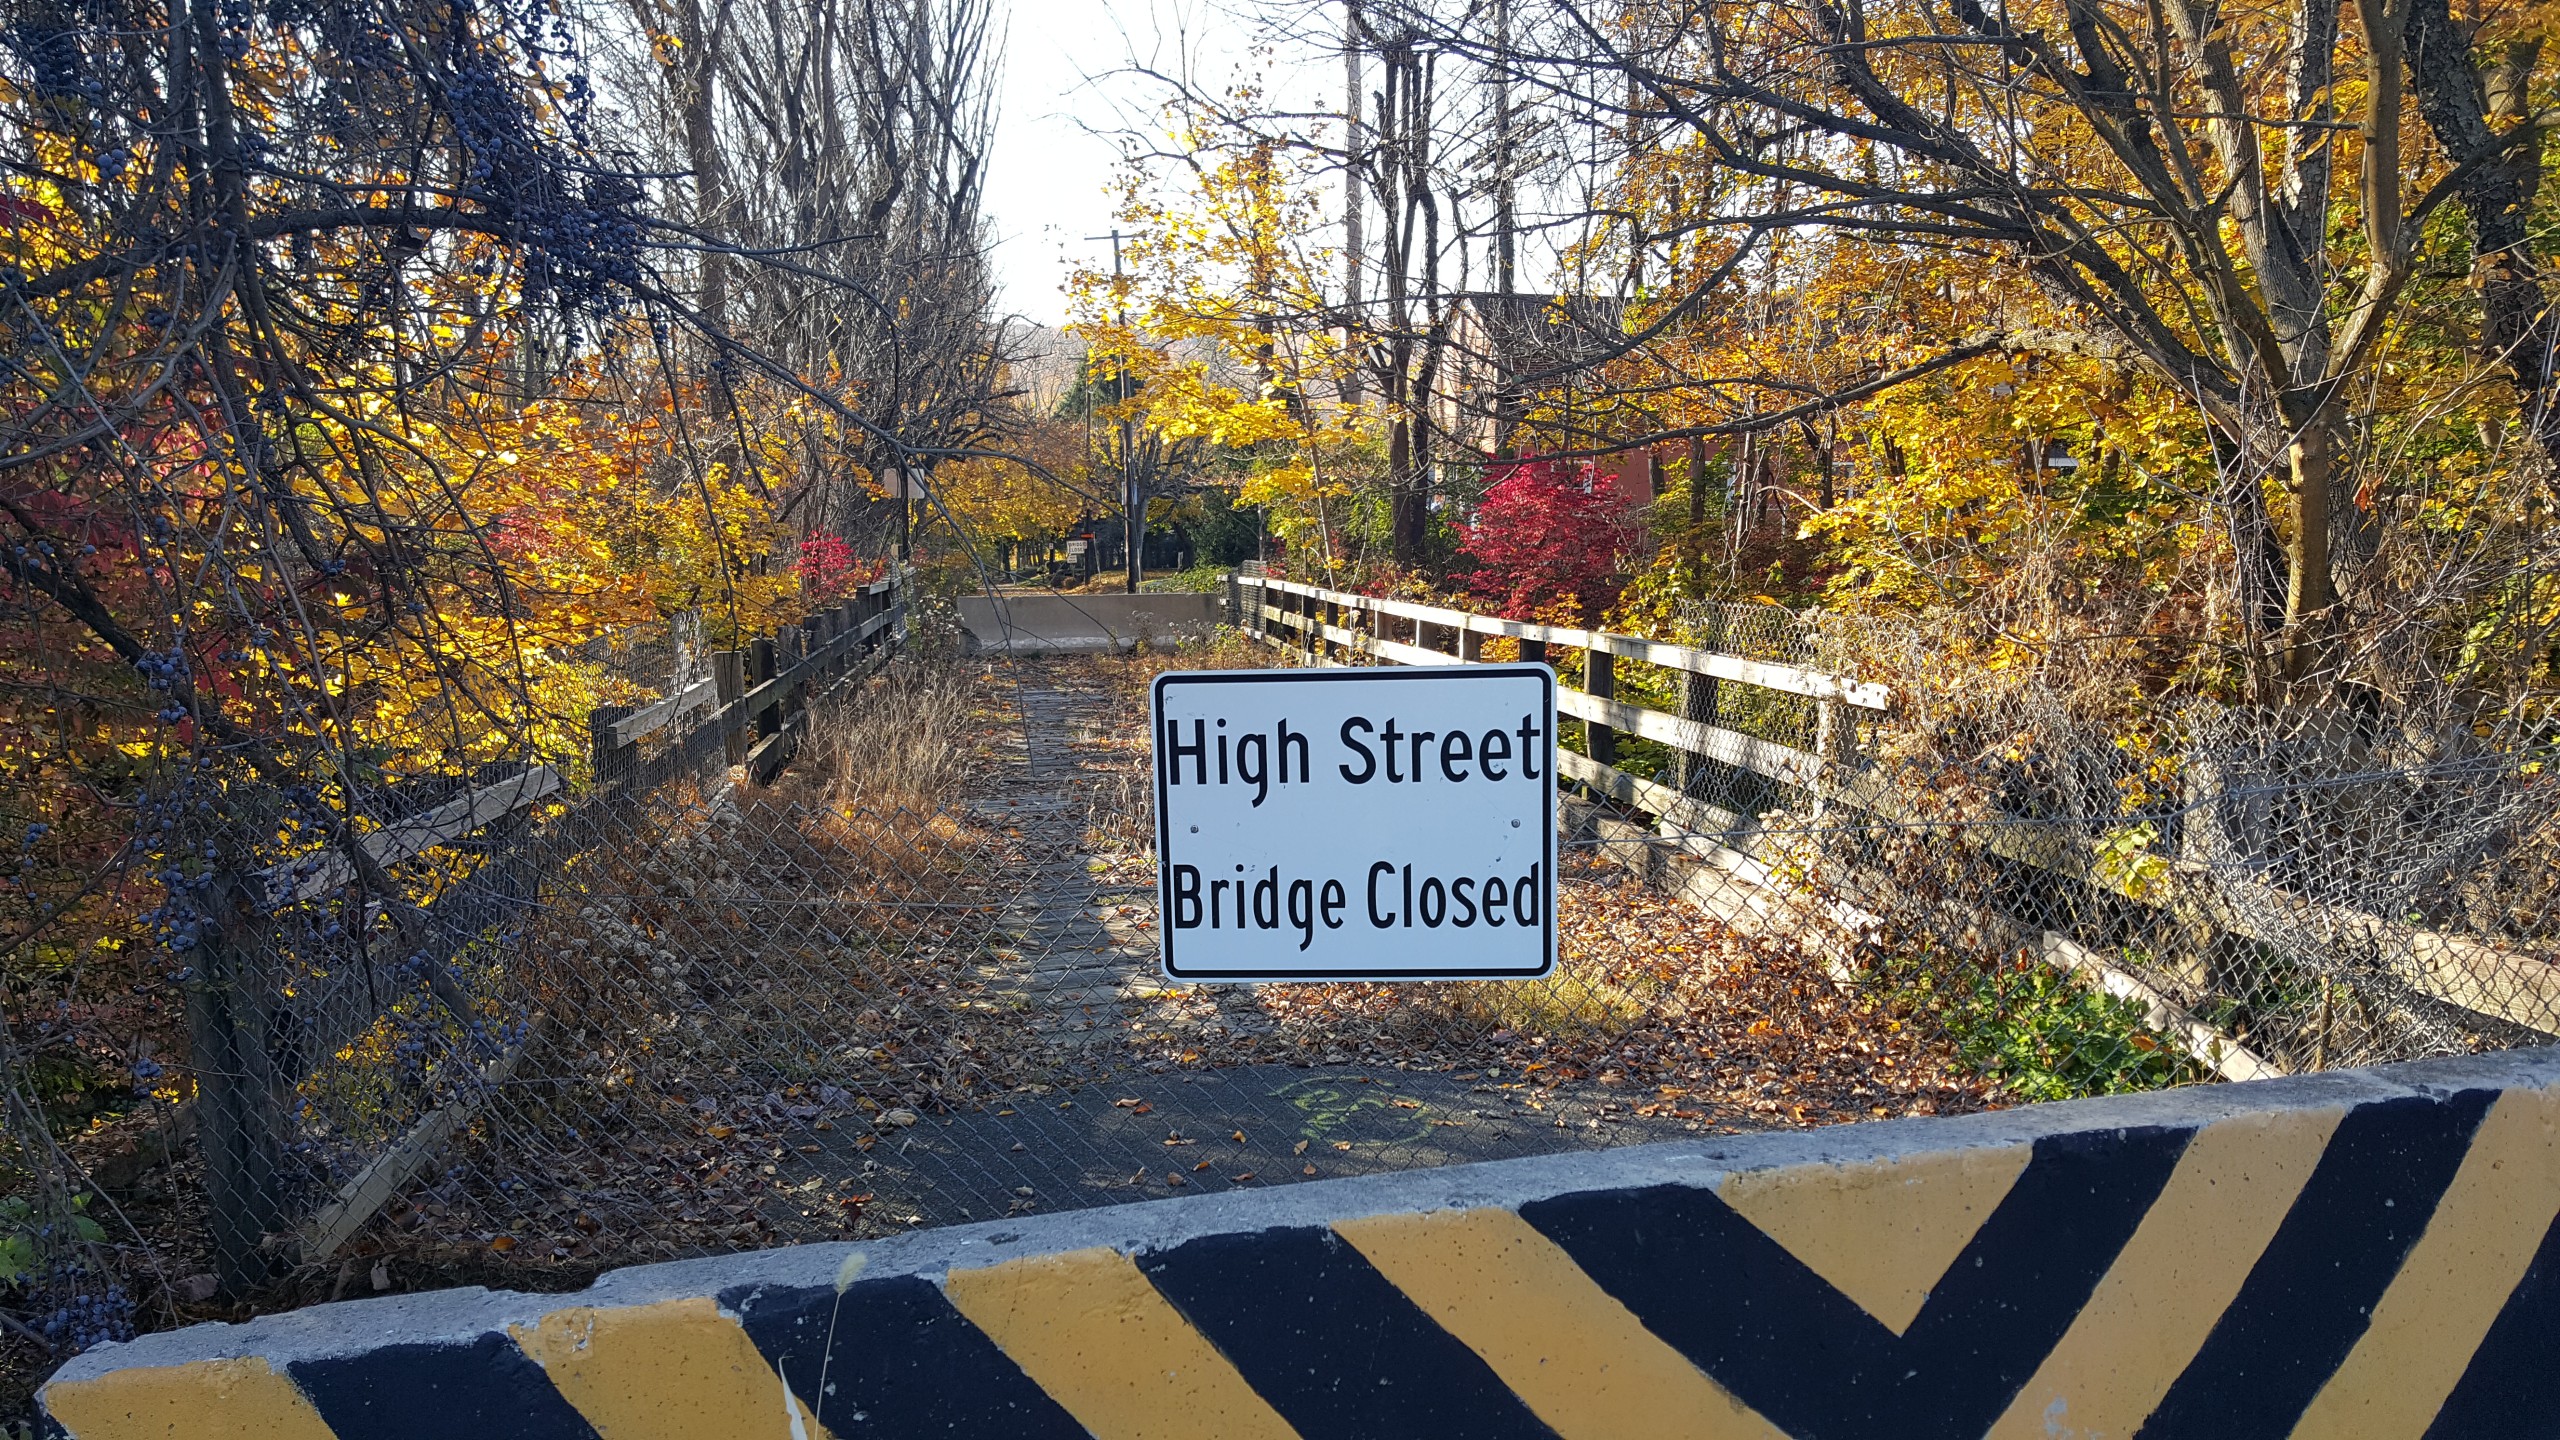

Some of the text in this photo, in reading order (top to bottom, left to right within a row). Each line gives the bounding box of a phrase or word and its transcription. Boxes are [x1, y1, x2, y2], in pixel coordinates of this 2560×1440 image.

[1167, 713, 1541, 809] High Street
[1172, 860, 1540, 952] Bridge Closed
